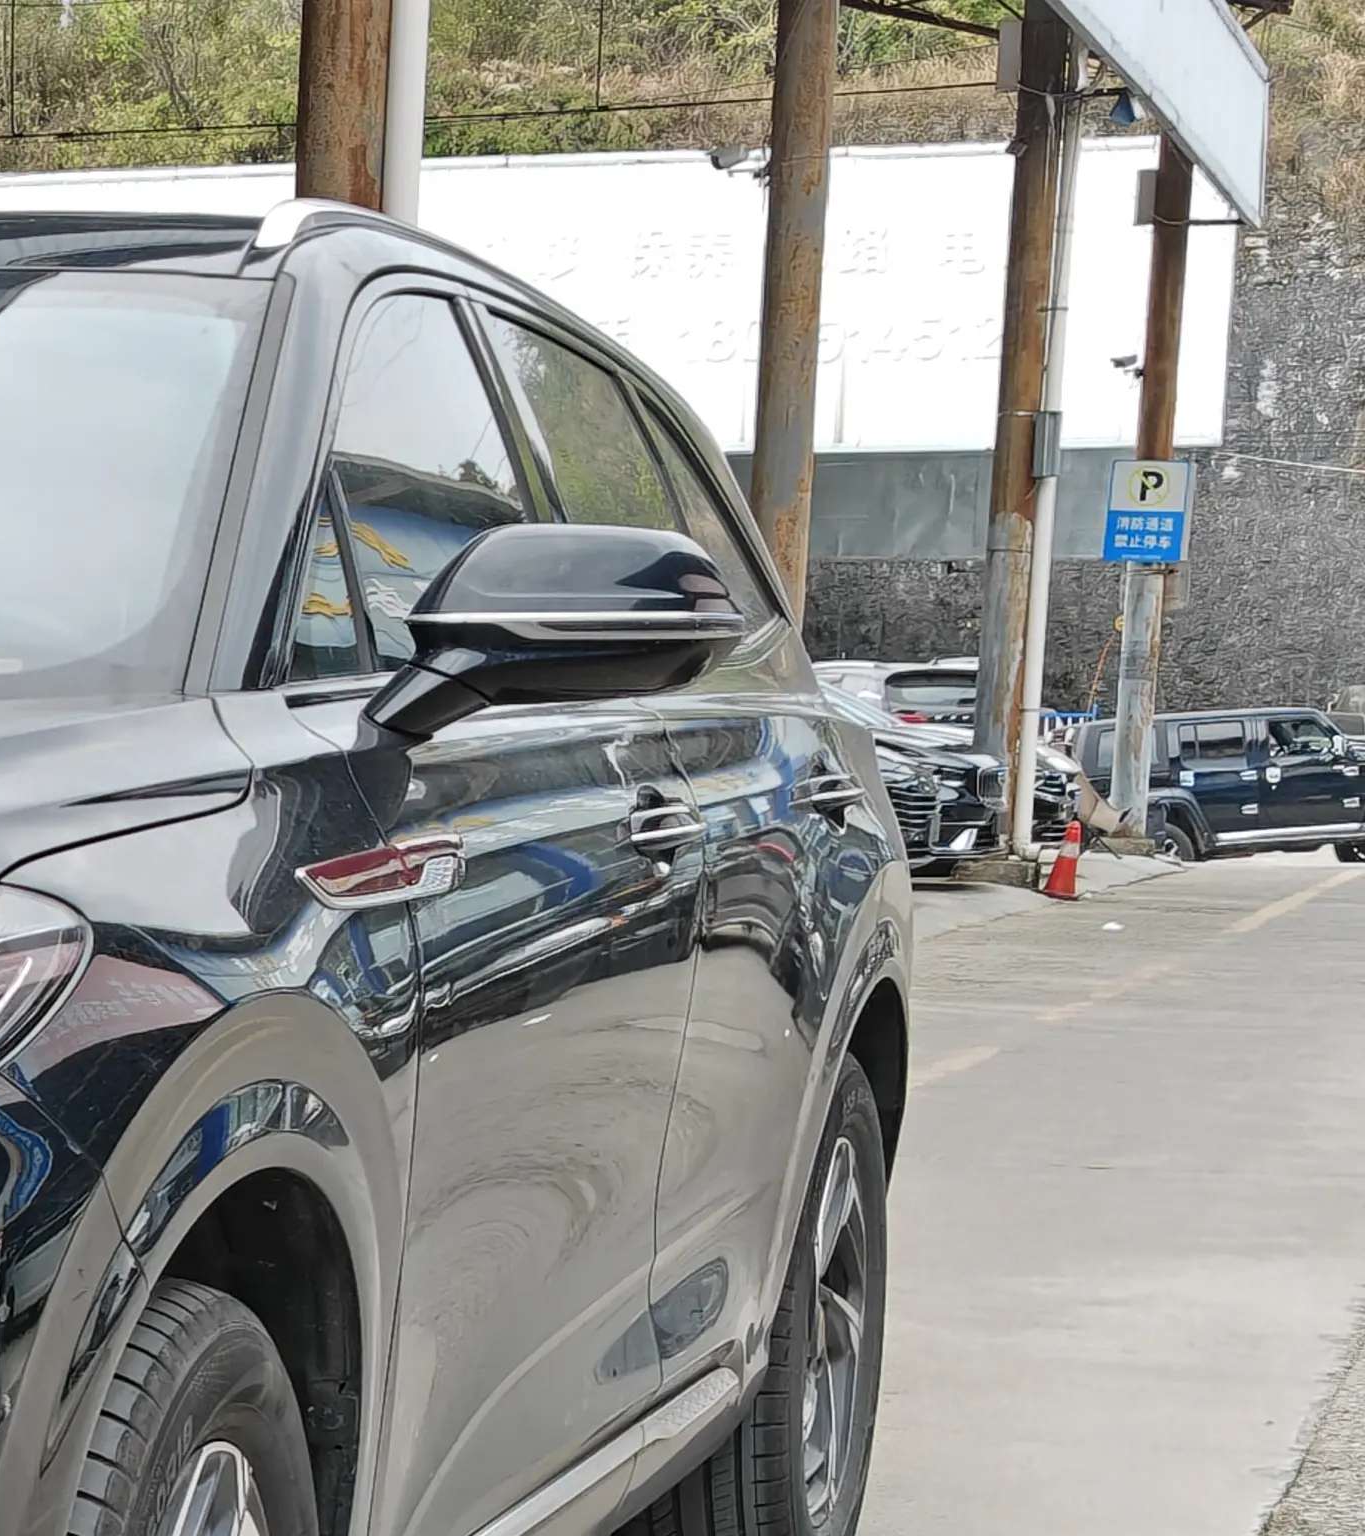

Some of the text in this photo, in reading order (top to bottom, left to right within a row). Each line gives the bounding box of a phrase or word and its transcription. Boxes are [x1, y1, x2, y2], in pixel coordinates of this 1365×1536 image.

[1116, 516, 1173, 531] 消防通道
[1114, 533, 1172, 549] 禁止停车
